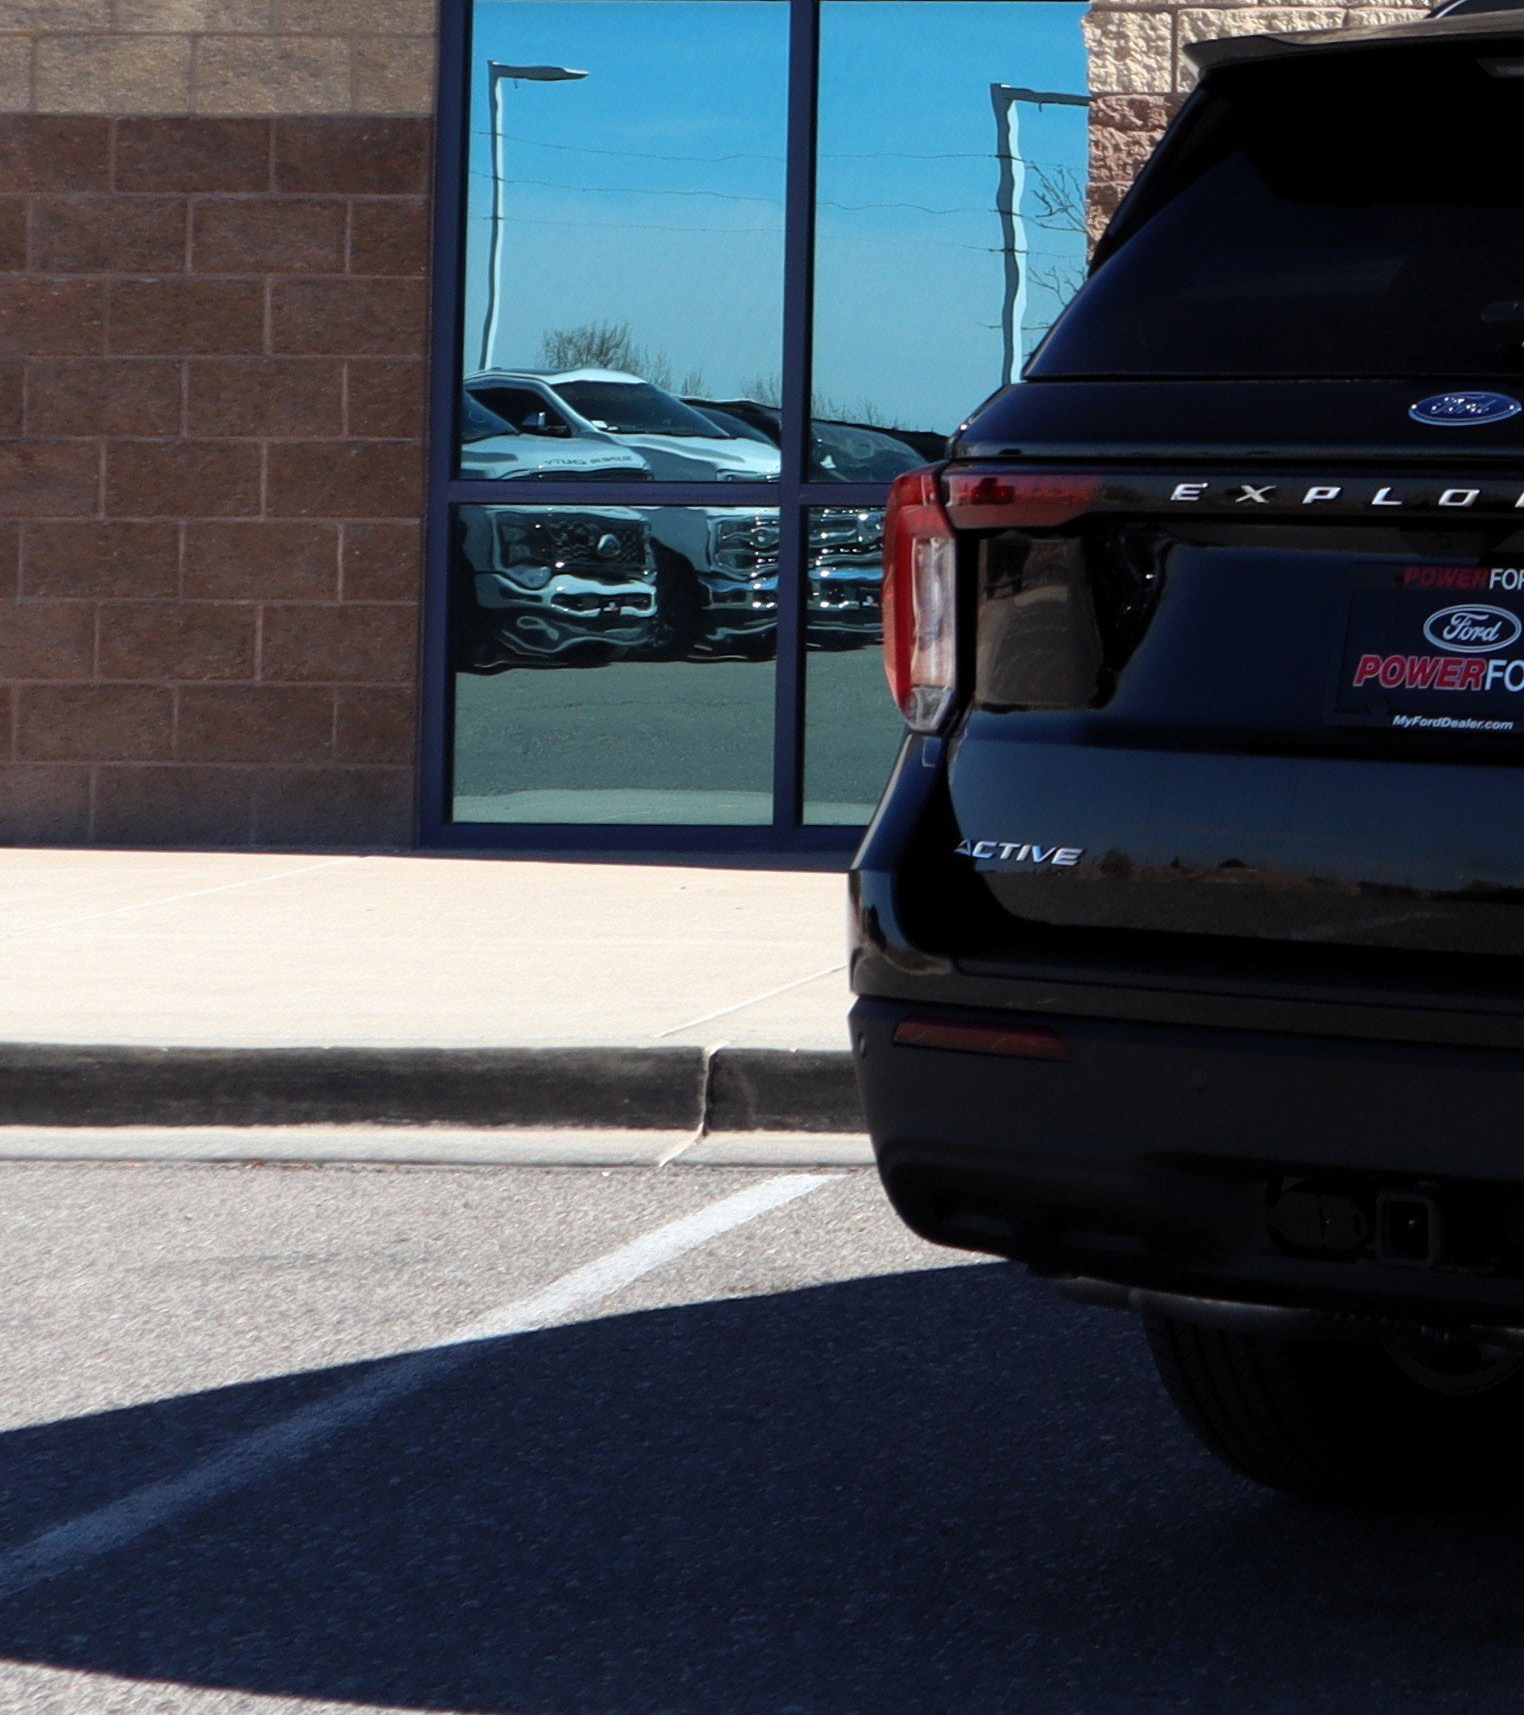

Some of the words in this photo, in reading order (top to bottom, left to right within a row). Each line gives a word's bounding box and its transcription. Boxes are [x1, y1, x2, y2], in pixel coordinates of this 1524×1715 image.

[1429, 393, 1498, 415] Ford
[1443, 612, 1503, 642] Ford
[1392, 714, 1514, 731] MyFordDealer.com
[954, 839, 1083, 866] ACTIVE
